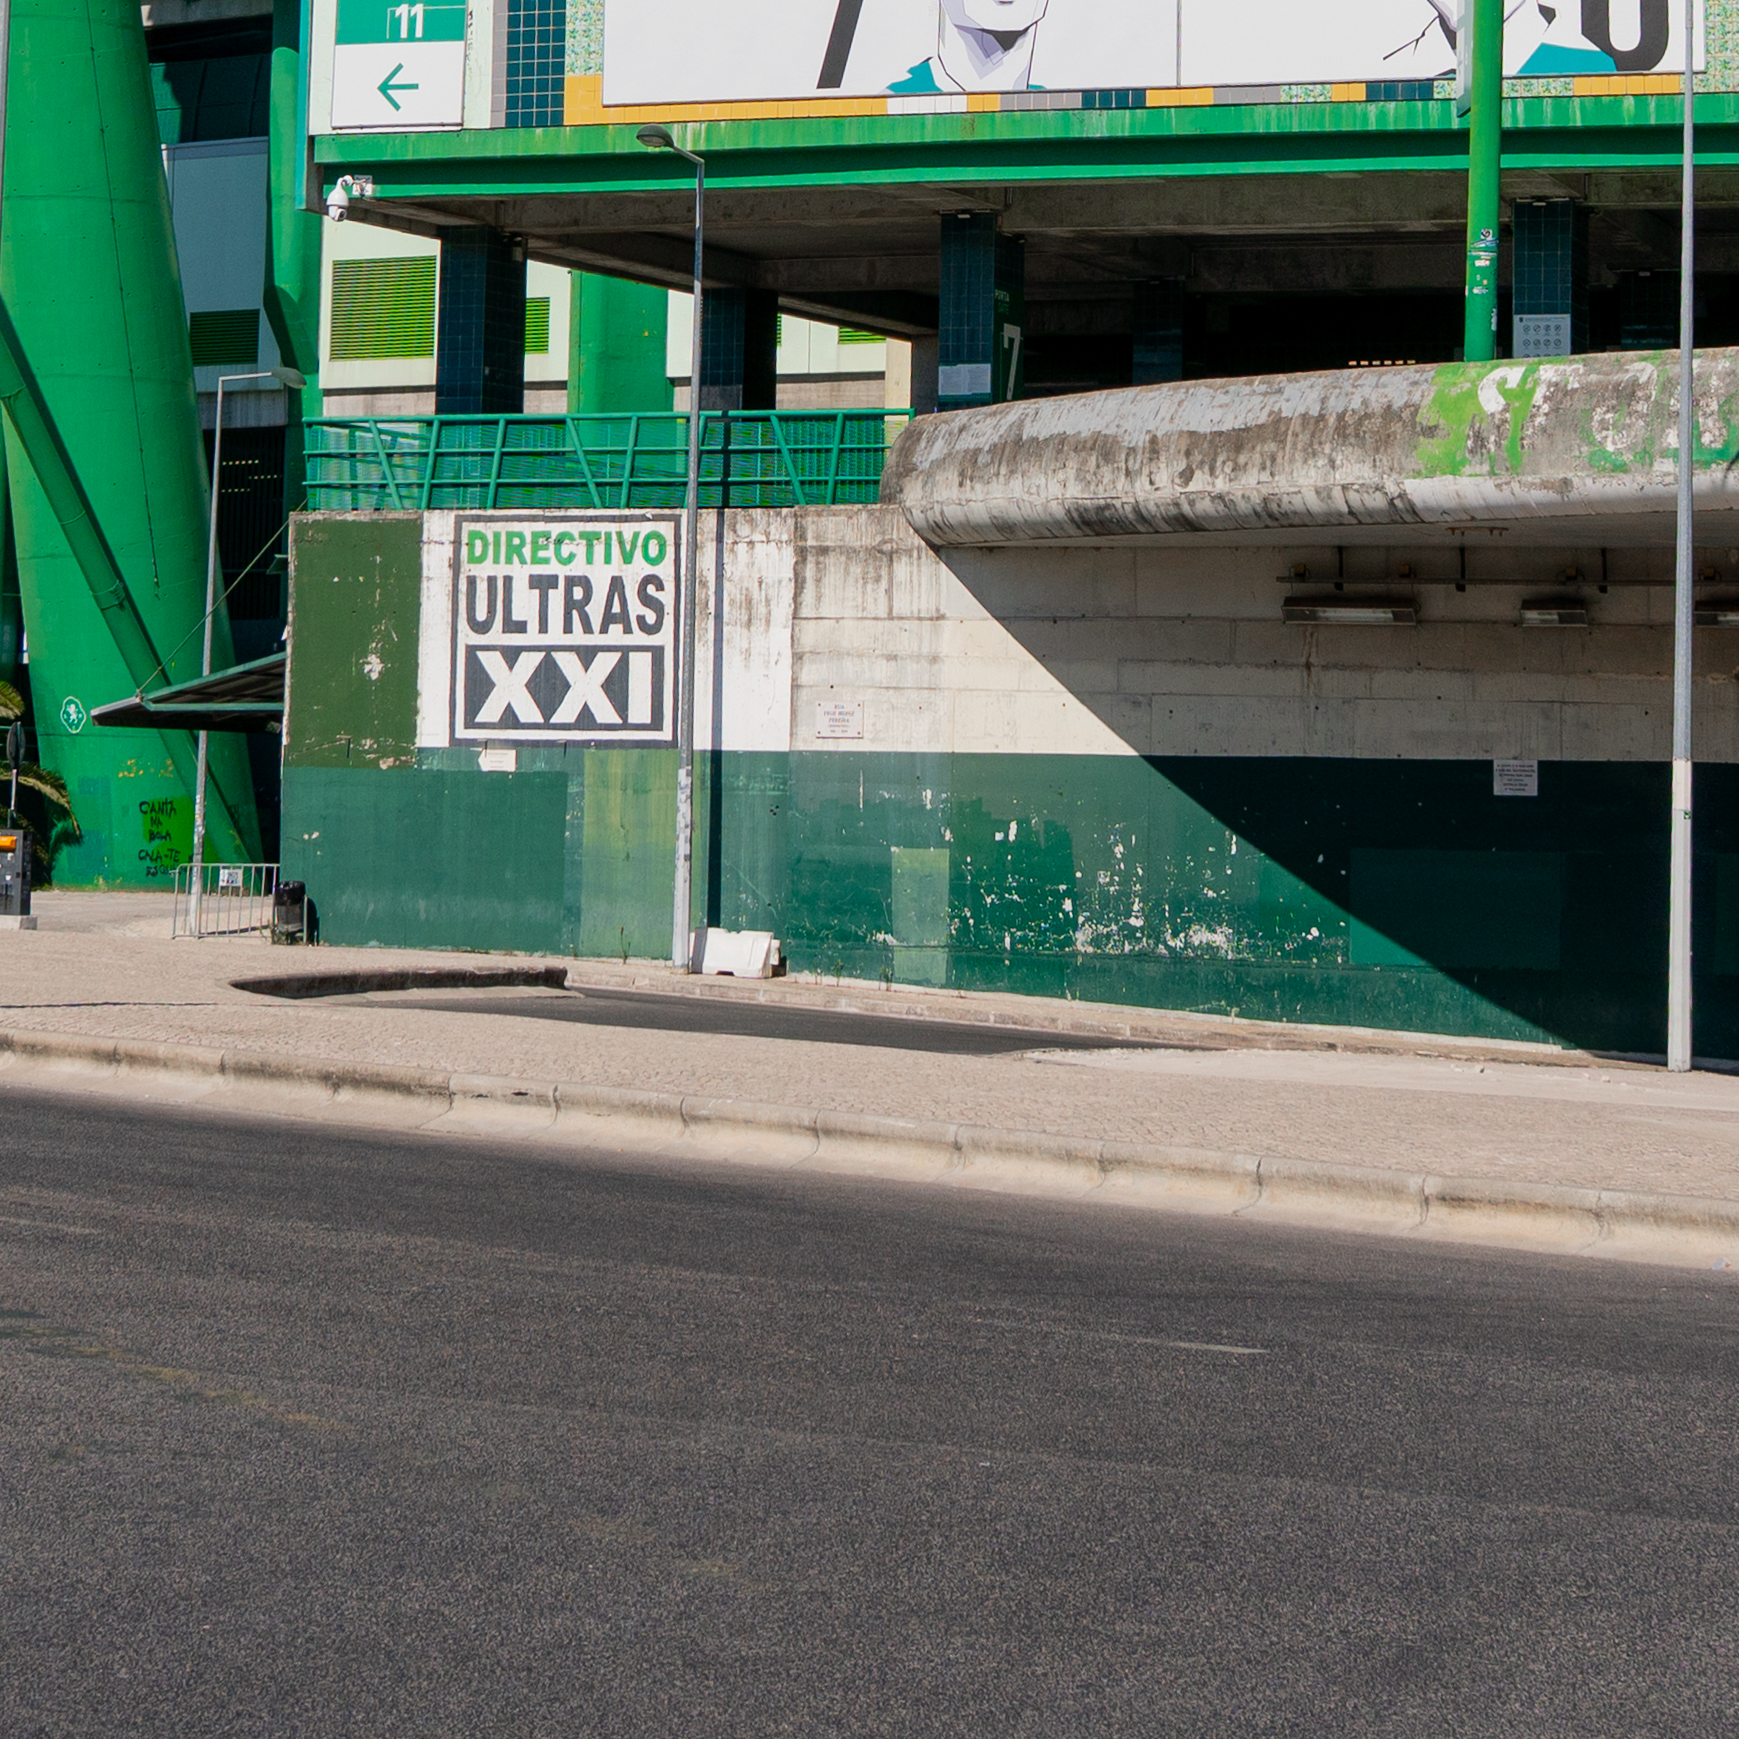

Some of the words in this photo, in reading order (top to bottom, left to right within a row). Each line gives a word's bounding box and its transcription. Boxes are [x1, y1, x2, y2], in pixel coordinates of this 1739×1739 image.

[395, 3, 424, 38] 11
[1003, 323, 1021, 401] 7
[466, 529, 667, 567] DIRECTIVO
[465, 573, 666, 636] ULTRAS
[474, 650, 655, 725] XXI
